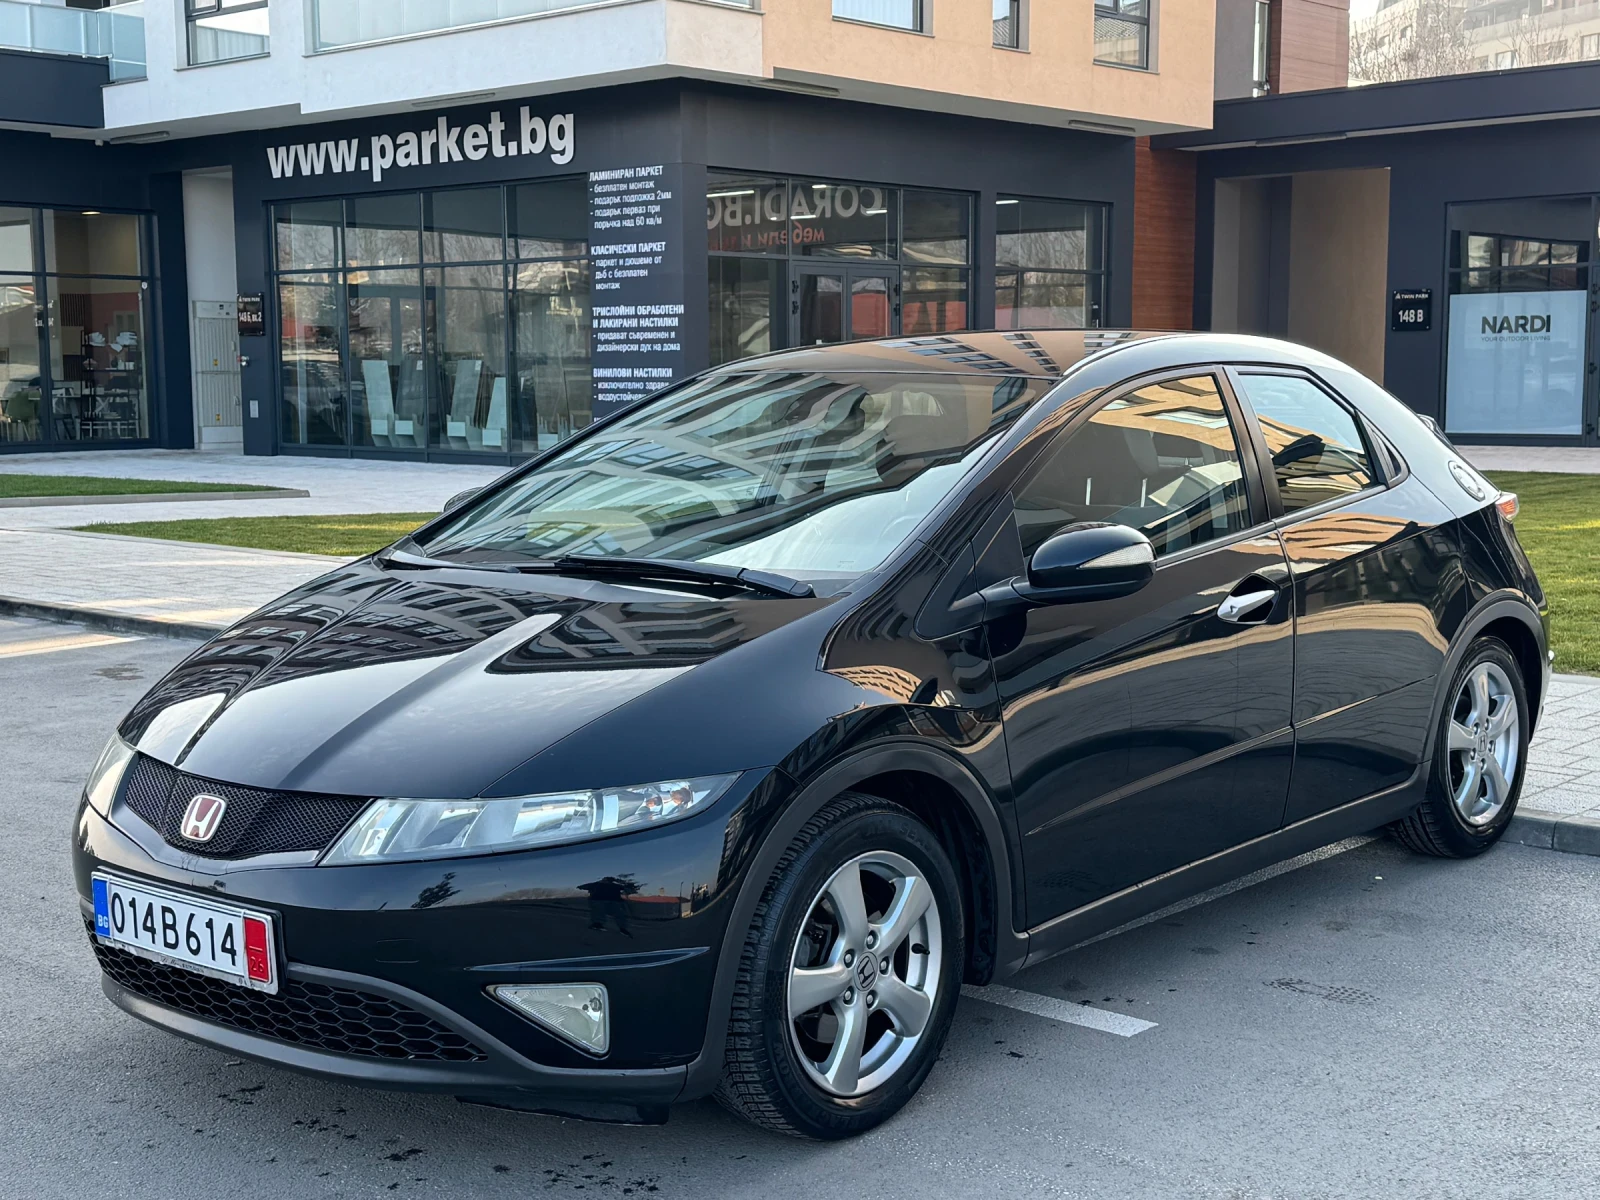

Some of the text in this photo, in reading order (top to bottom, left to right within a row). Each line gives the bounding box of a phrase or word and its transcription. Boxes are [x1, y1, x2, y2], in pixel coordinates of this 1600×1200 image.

[266, 105, 574, 183] www.parket.bg
[589, 166, 663, 181] ЛАМИНИРАН ПАРКЕТ
[594, 181, 654, 193] безплатен монтаж
[595, 195, 621, 205] подарък
[657, 190, 671, 200] 2мм
[595, 205, 660, 217] подарък перваз при
[595, 219, 620, 230] поръчка
[622, 218, 634, 227] над
[636, 216, 644, 225] 60
[591, 242, 666, 255] КЛАСИЧЕСКИ ПАРКЕТ
[596, 258, 617, 268] паркет
[614, 269, 648, 277] безплатен
[596, 282, 620, 290] монтаж
[593, 305, 684, 316] ТРИСЛОЙНИ ОБРАБОТЕНИ
[1398, 309, 1415, 323] 148
[593, 317, 678, 328] И ЛАКИРАНИ НАСТИЛКИ
[1481, 314, 1551, 334] NARDI
[598, 332, 626, 341] придават
[629, 331, 669, 340] съвременен
[640, 343, 651, 352] дух
[663, 343, 680, 351] дома
[593, 368, 672, 377] ВИНИЛОВИ НАСТИЛКИ
[97, 913, 109, 929] BG
[111, 892, 237, 966] 014B614
[250, 956, 264, 973] 26
